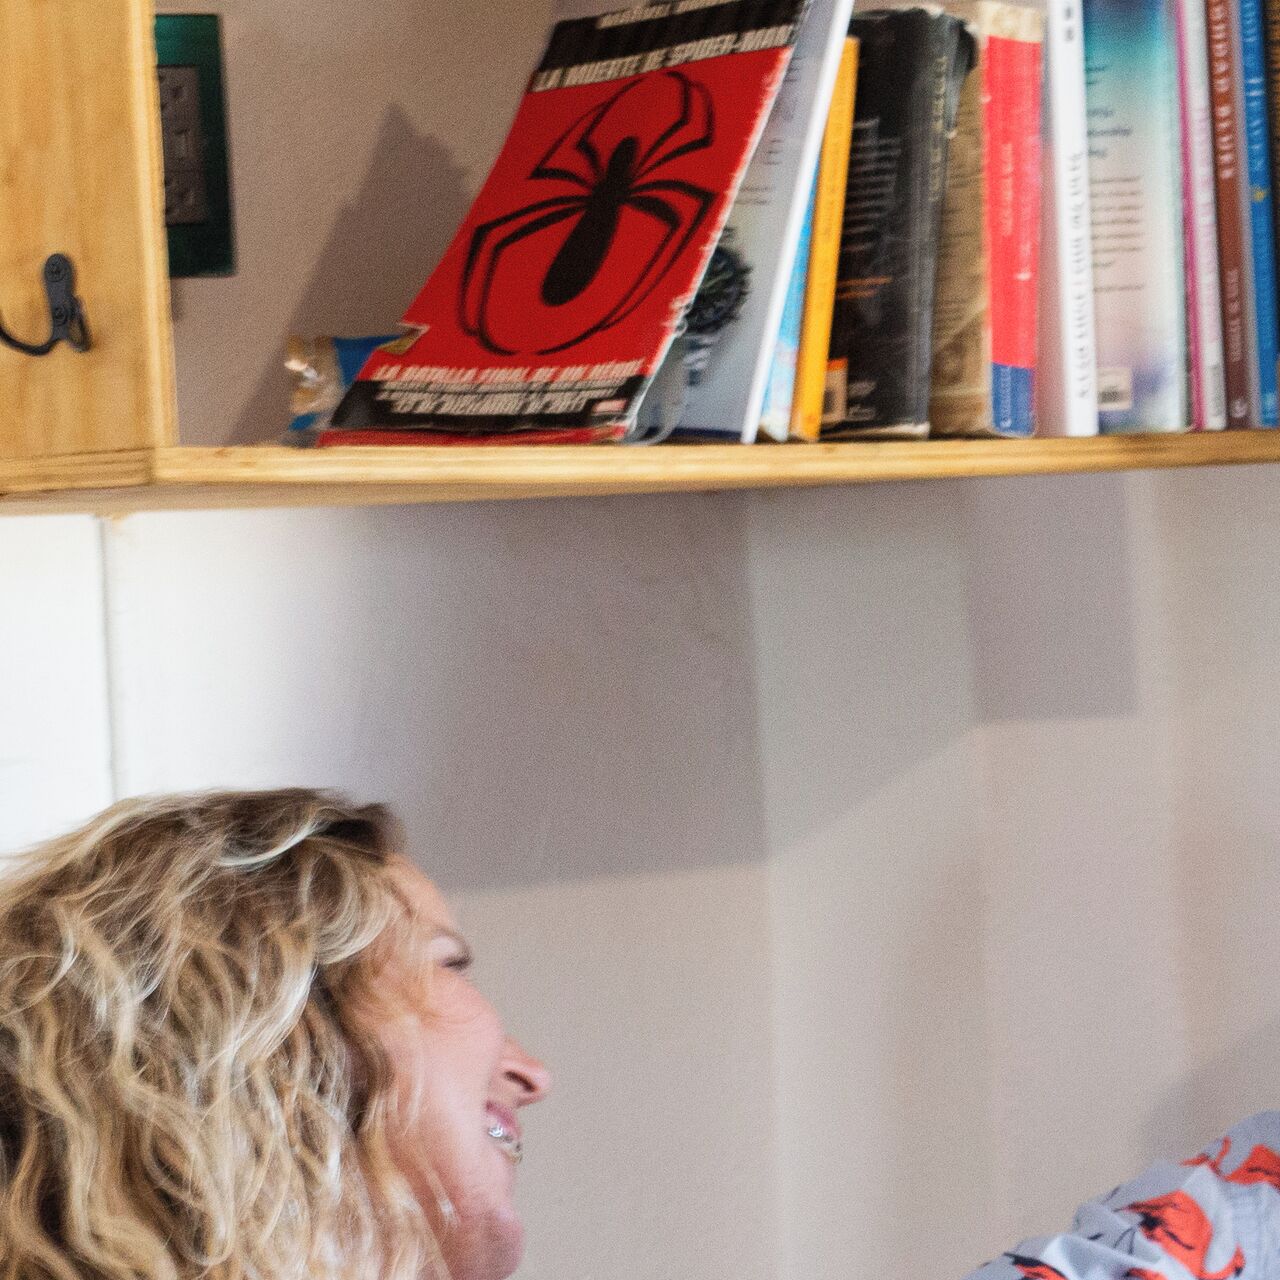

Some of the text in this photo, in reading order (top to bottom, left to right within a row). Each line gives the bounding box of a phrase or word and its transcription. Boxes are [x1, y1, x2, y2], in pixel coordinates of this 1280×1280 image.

[529, 24, 796, 92] LA MUERTE DE SPIDER-MAN
[371, 364, 403, 381] LA
[401, 364, 478, 383] BATALLA
[476, 366, 530, 383] FINAL
[528, 366, 557, 383] DE
